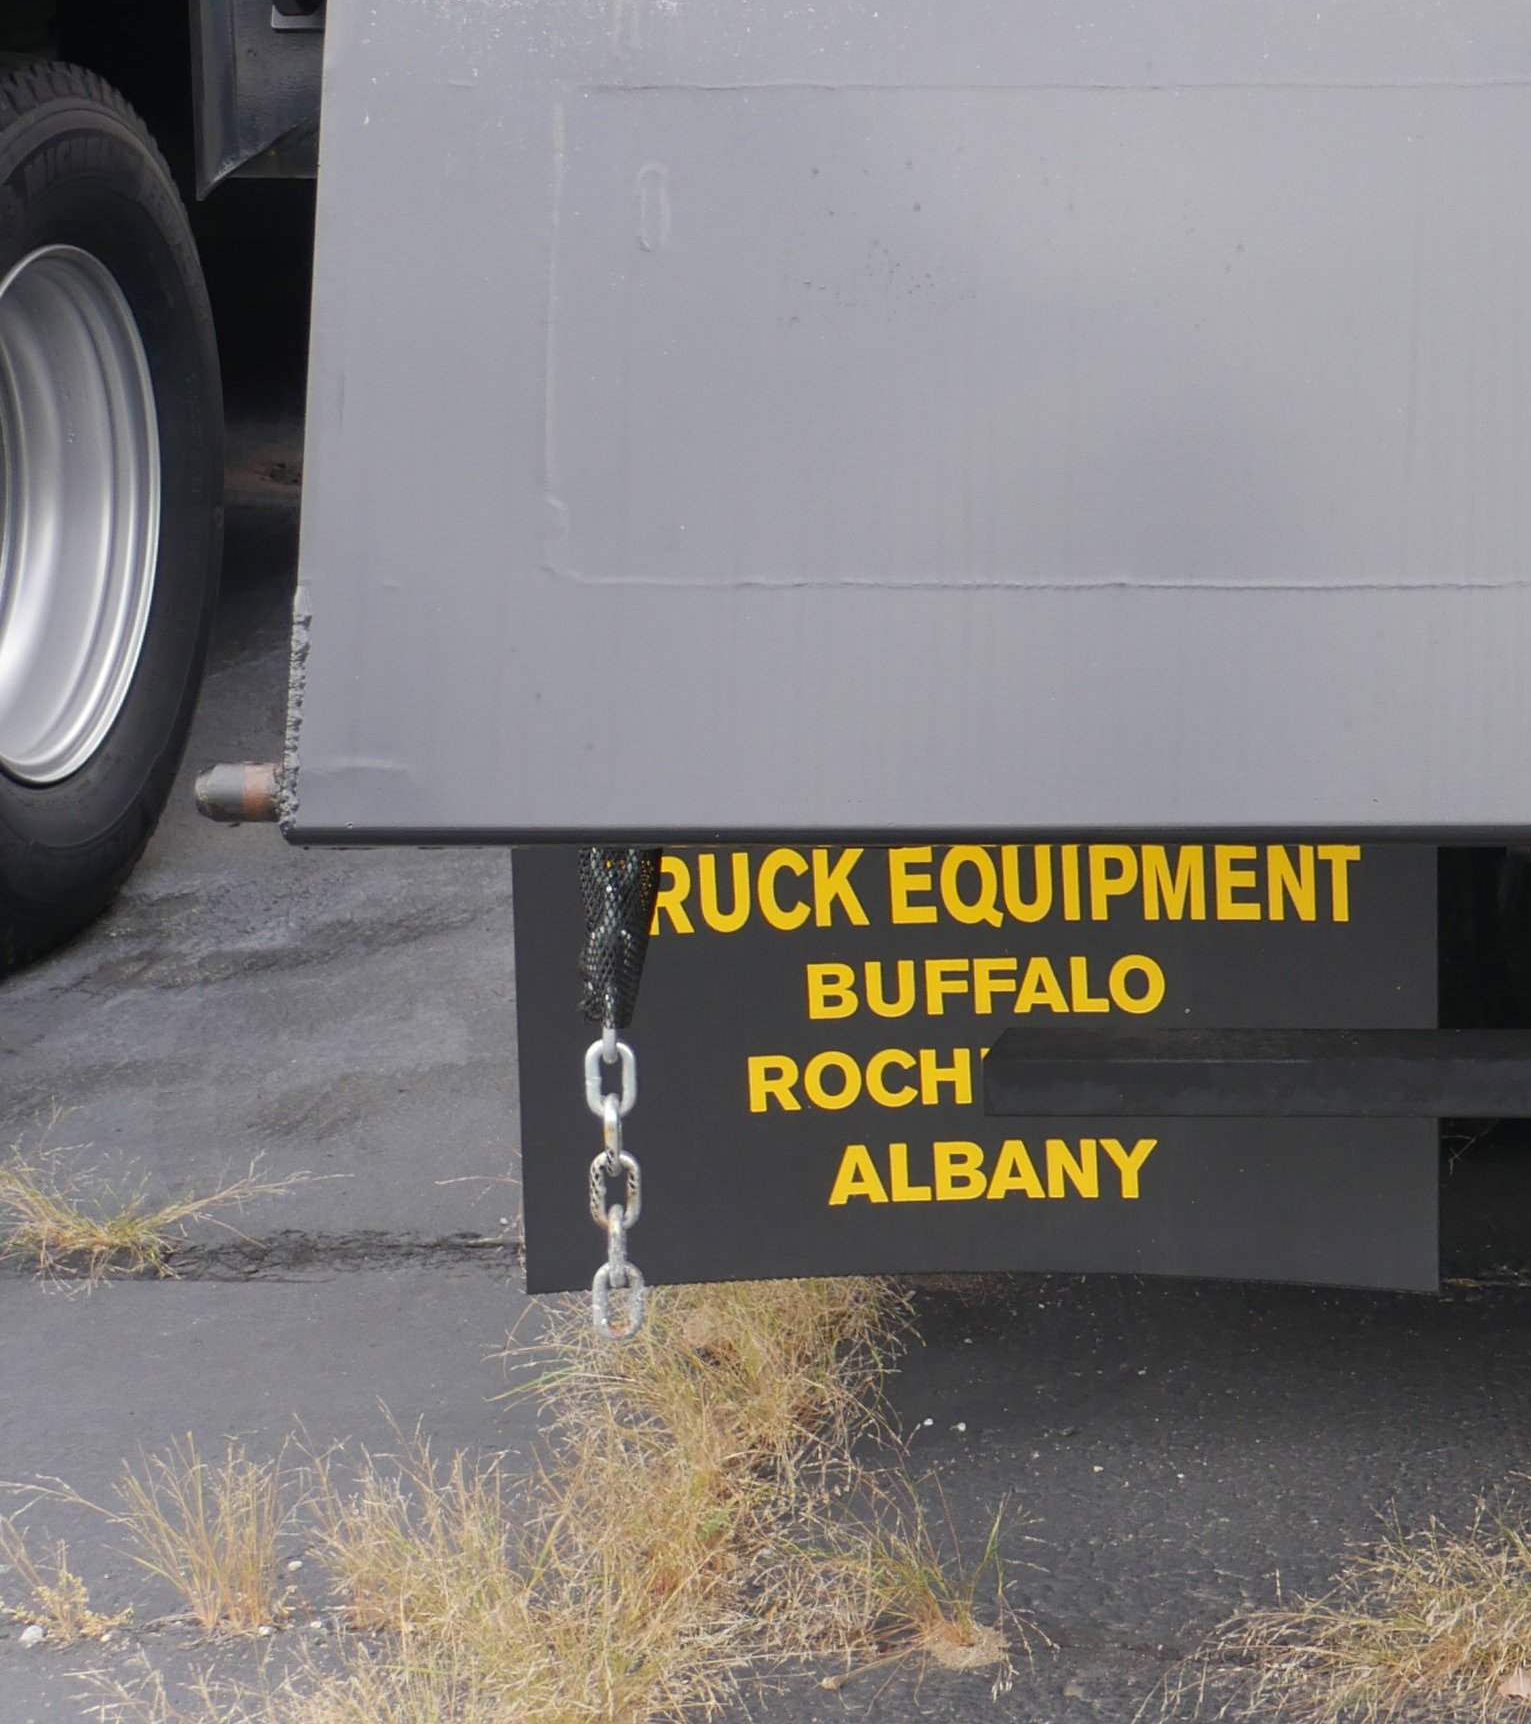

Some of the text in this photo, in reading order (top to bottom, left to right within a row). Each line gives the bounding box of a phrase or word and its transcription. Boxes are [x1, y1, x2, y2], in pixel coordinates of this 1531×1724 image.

[648, 843, 1361, 937] RUCK EQUIPMENT
[805, 953, 1166, 1021] BUFFALO
[746, 1046, 991, 1114] ROCH
[827, 1137, 1159, 1207] ALBANY
